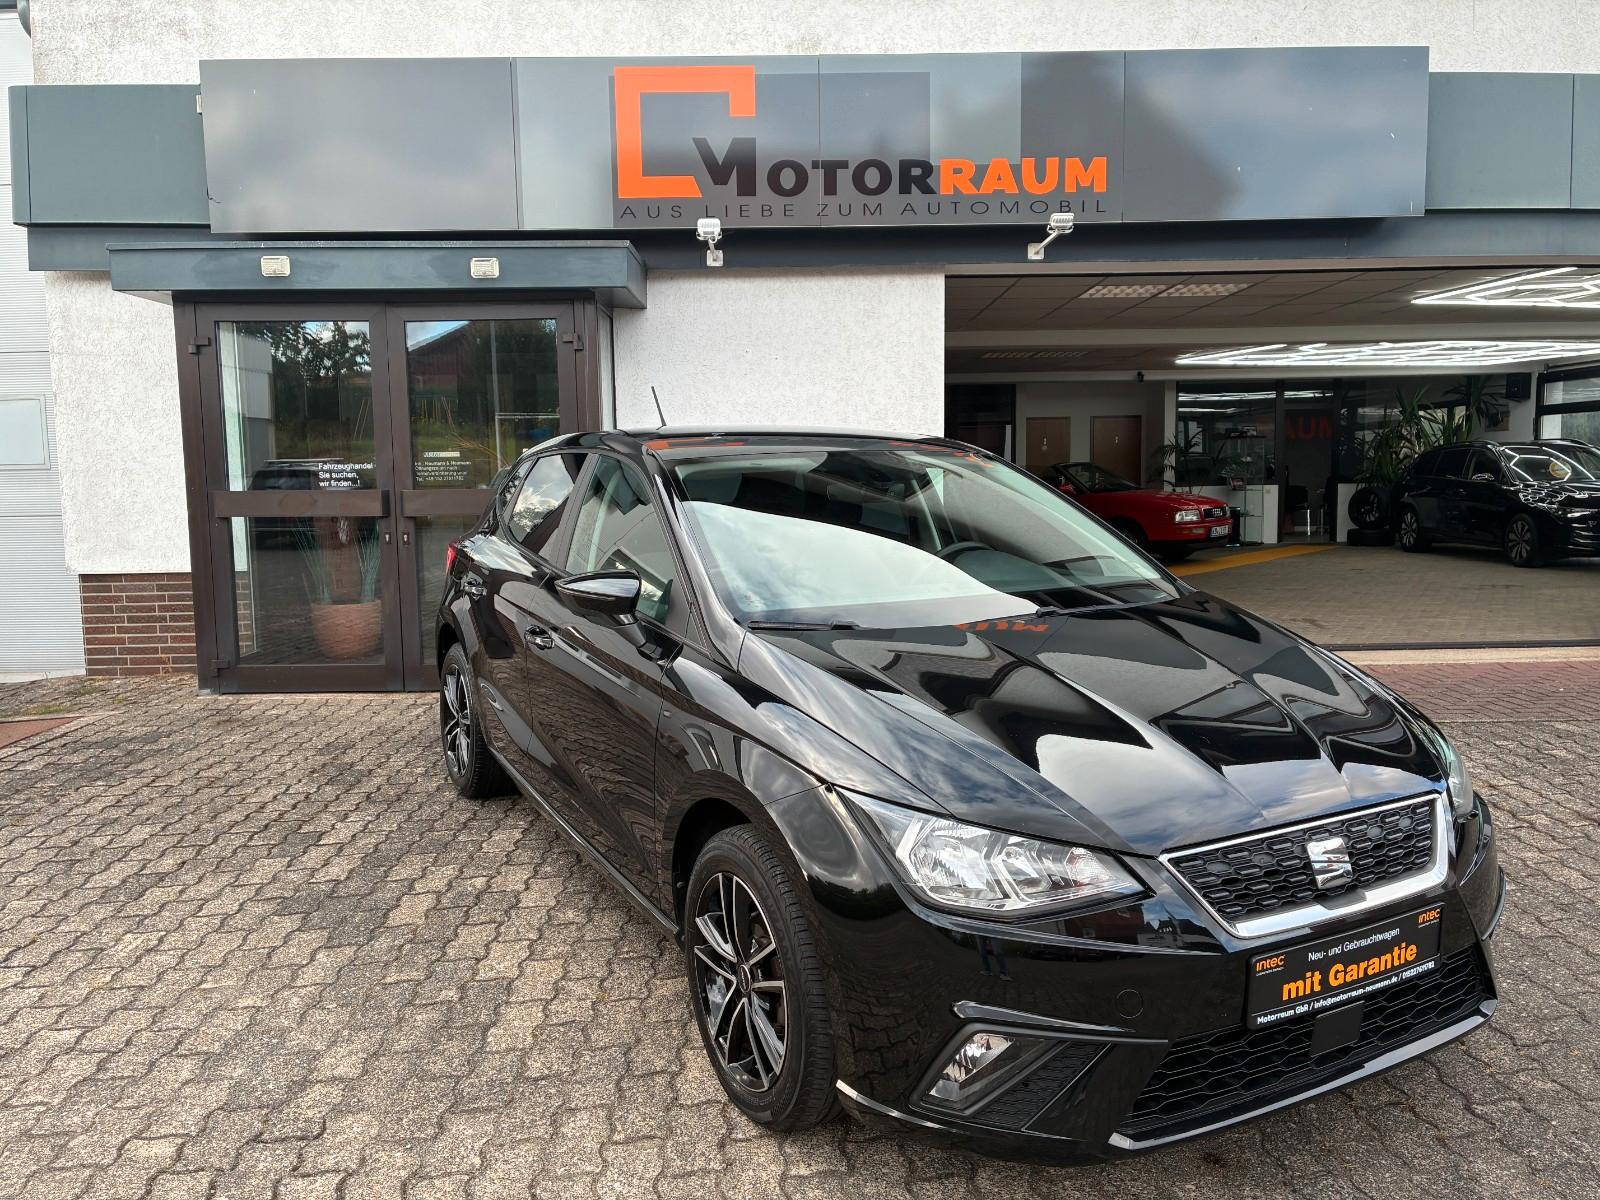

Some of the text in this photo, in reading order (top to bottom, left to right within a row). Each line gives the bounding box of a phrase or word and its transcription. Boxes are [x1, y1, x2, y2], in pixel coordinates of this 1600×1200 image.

[621, 199, 1106, 219] AUS LIEBE ZUM AUTOMOBIL
[318, 462, 373, 471] Fahrzeughandel
[318, 471, 359, 479] Sie suchen,
[1418, 909, 1441, 924] intec
[1308, 928, 1400, 962] Neu- und Gebrauchtwagen
[1256, 955, 1286, 972] intec
[1282, 942, 1418, 1001] mit Garantie
[1257, 1009, 1295, 1025] Motorraum
[1295, 1004, 1310, 1014] GbR
